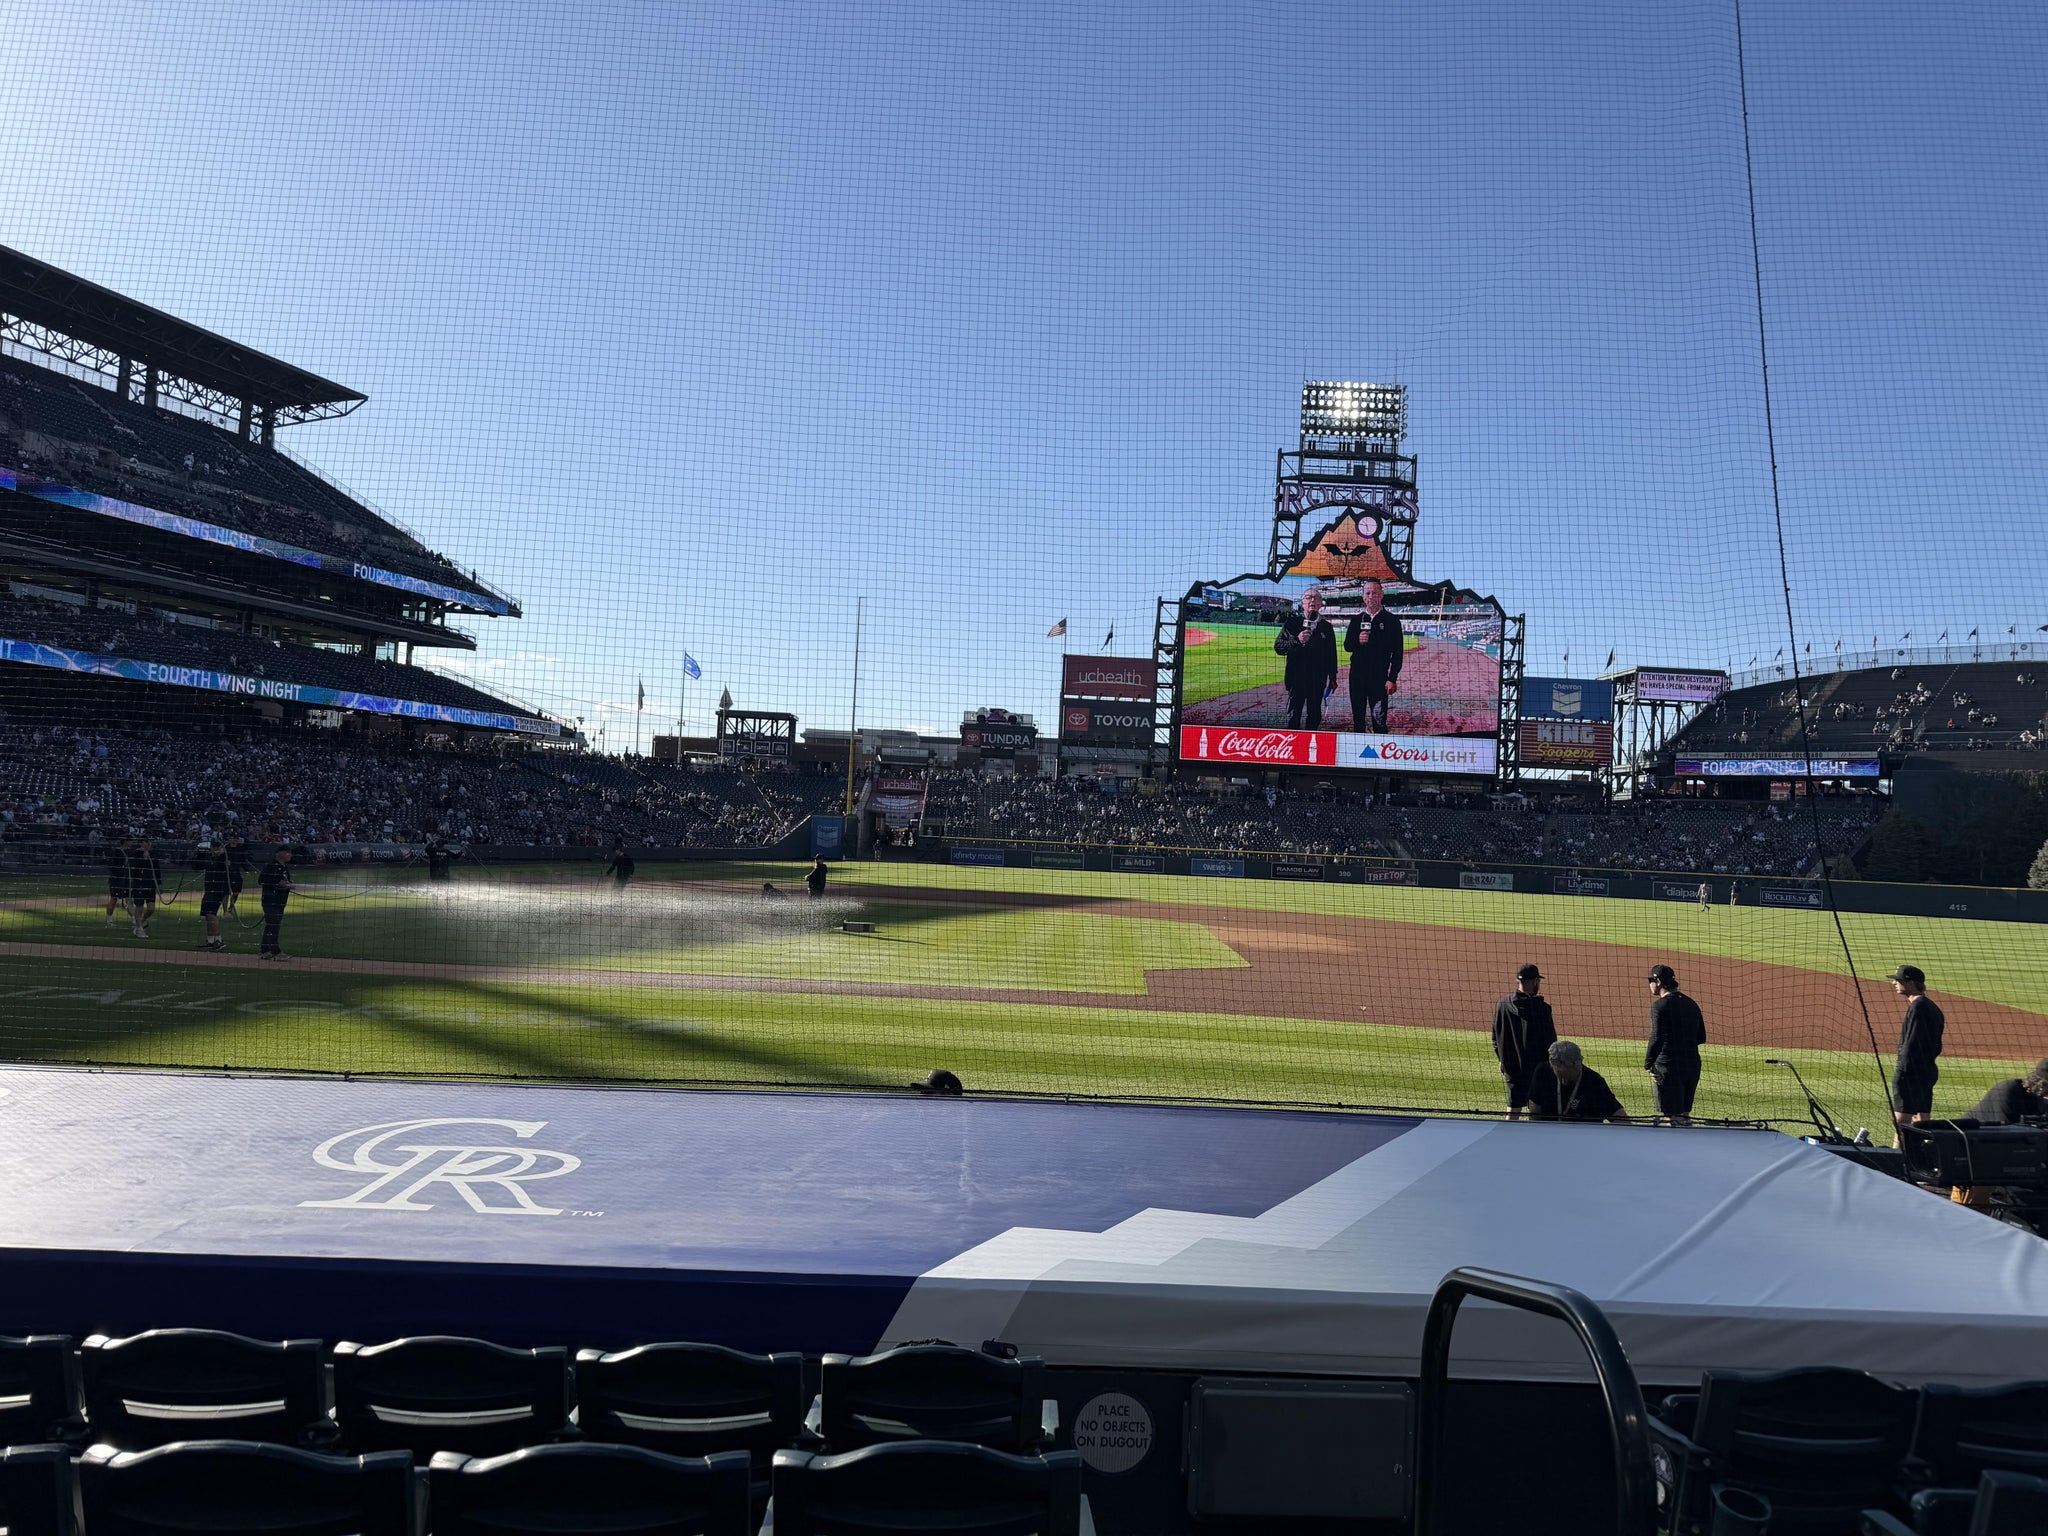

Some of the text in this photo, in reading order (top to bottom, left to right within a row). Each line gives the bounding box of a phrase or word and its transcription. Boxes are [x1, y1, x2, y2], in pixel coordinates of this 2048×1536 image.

[1279, 482, 1419, 521] ROCKIES
[148, 663, 302, 700] FOURTH WING NIGHT
[1079, 668, 1142, 685] uchealth
[1640, 673, 1667, 681] ATTENTION
[1640, 681, 1648, 689] WE
[1666, 683, 1687, 691] SPECIAL
[472, 710, 503, 727] NIGHT
[1094, 714, 1151, 728] TOYOTA
[981, 733, 1031, 746] TUNDRA
[1537, 724, 1595, 744] KING
[1218, 731, 1294, 760] Coca-Cola
[1381, 741, 1476, 764] Coors LIGHT
[1537, 742, 1596, 759] Soopers
[883, 779, 922, 790] uchealth
[1481, 875, 1496, 884] 24/7
[1098, 1405, 1130, 1416] PLACE
[1081, 1420, 1146, 1433] NO OBJECTS
[1077, 1436, 1149, 1449] ON DUGOUT
